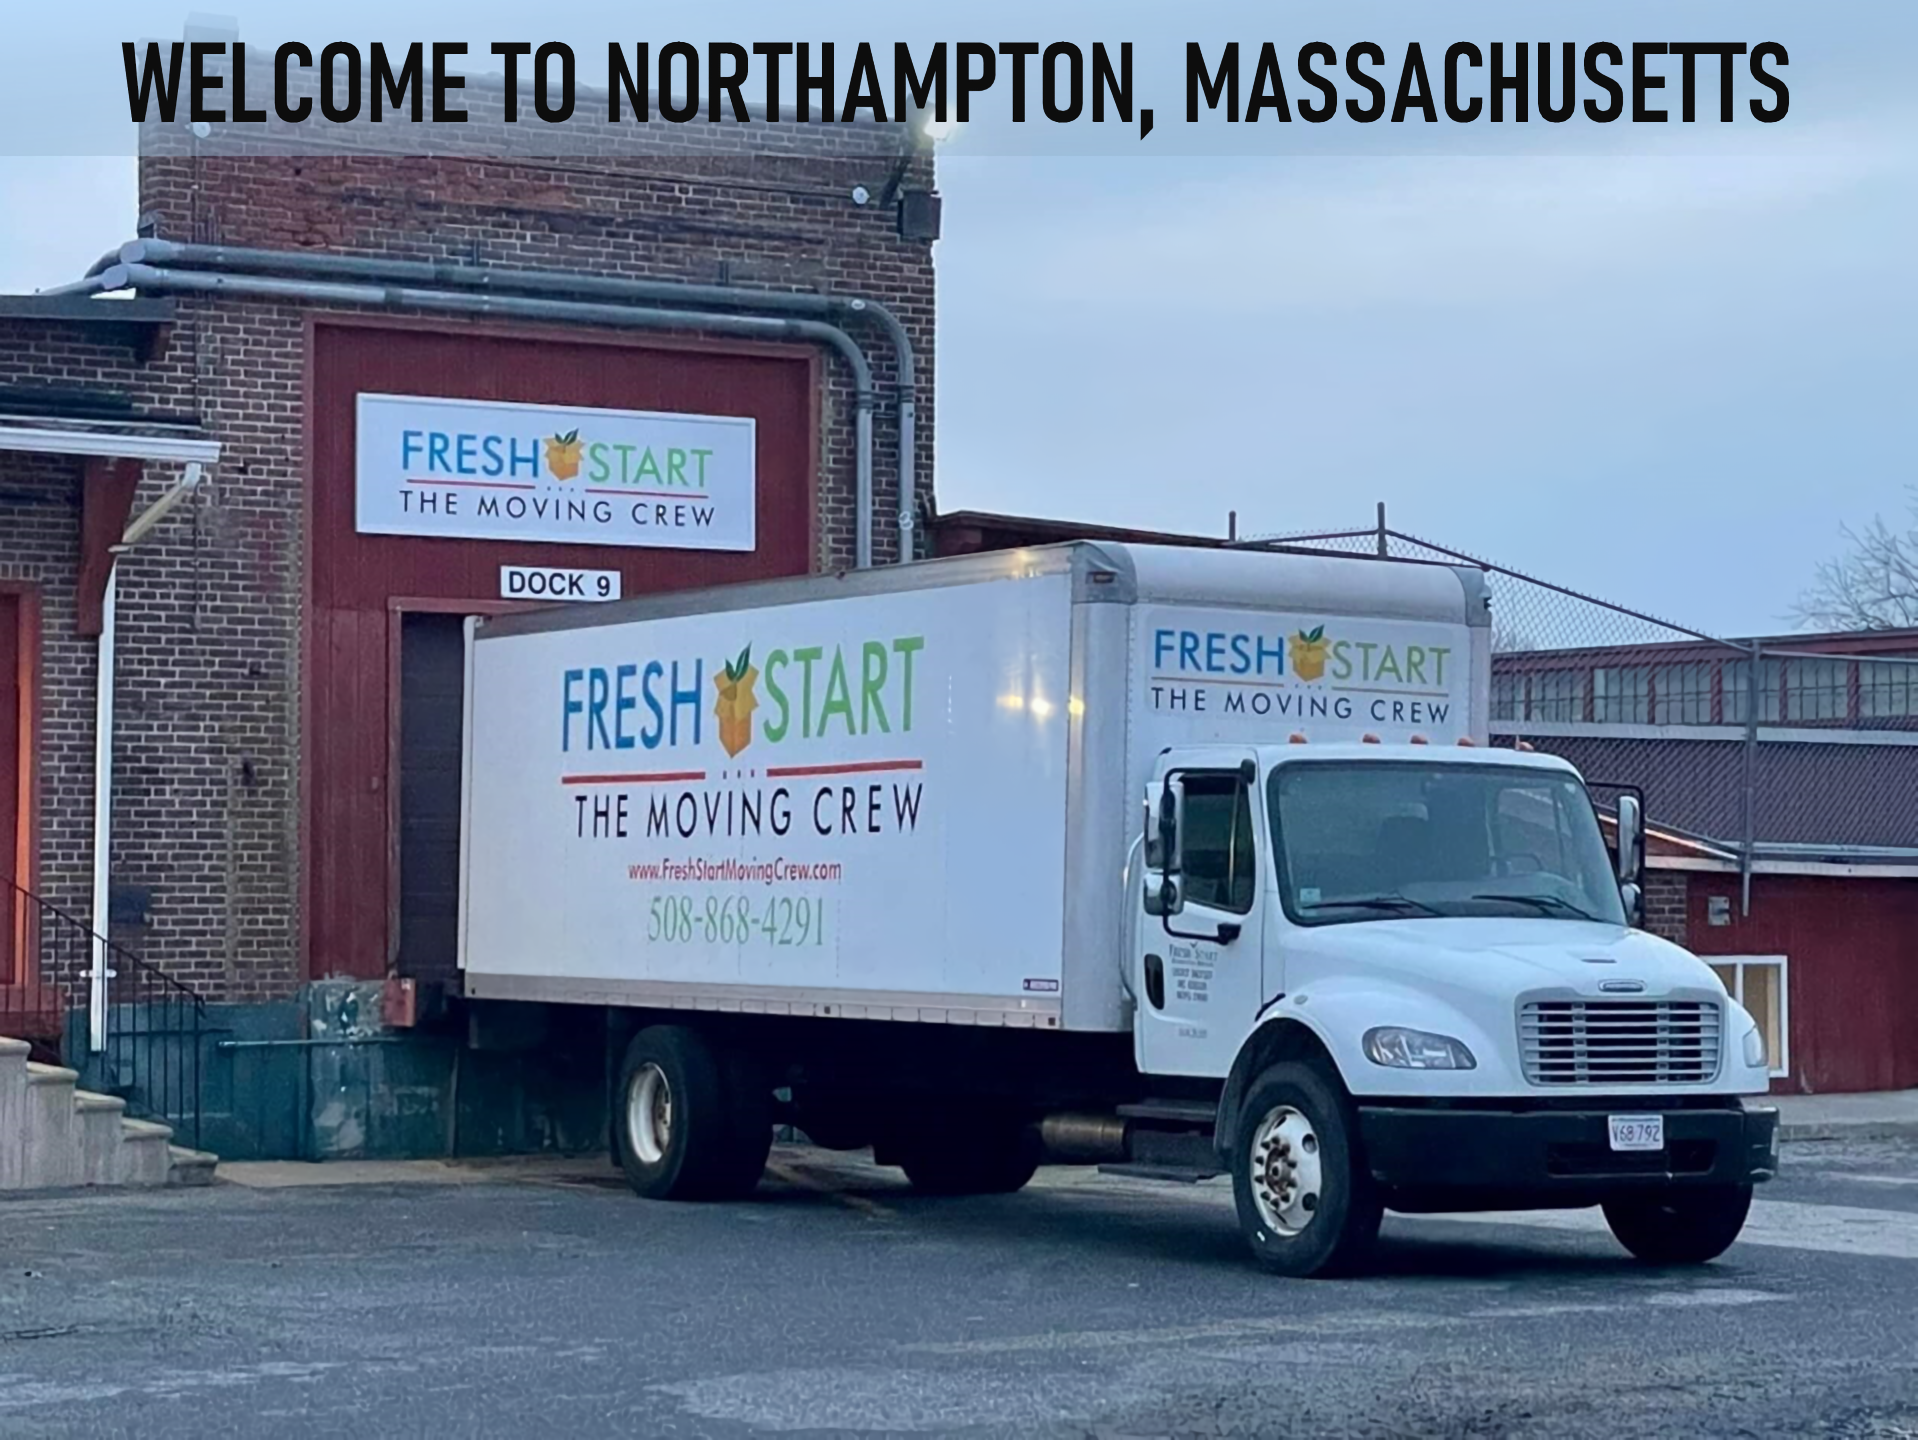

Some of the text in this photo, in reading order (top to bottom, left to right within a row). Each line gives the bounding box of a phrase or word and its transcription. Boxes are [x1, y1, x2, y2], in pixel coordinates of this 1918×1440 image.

[402, 430, 713, 488] FRESH START
[399, 490, 715, 528] THE MOVING CREW
[508, 570, 611, 597] DOCK 9
[1154, 629, 1451, 686] FRESH START
[562, 636, 924, 752] FRESH START
[1151, 687, 1450, 724] THE MOVING CREW
[575, 782, 923, 839] THE MOVING CREW
[627, 856, 842, 886] www.FreshStartMovingCrew.com
[647, 895, 824, 948] 508-868-4291
